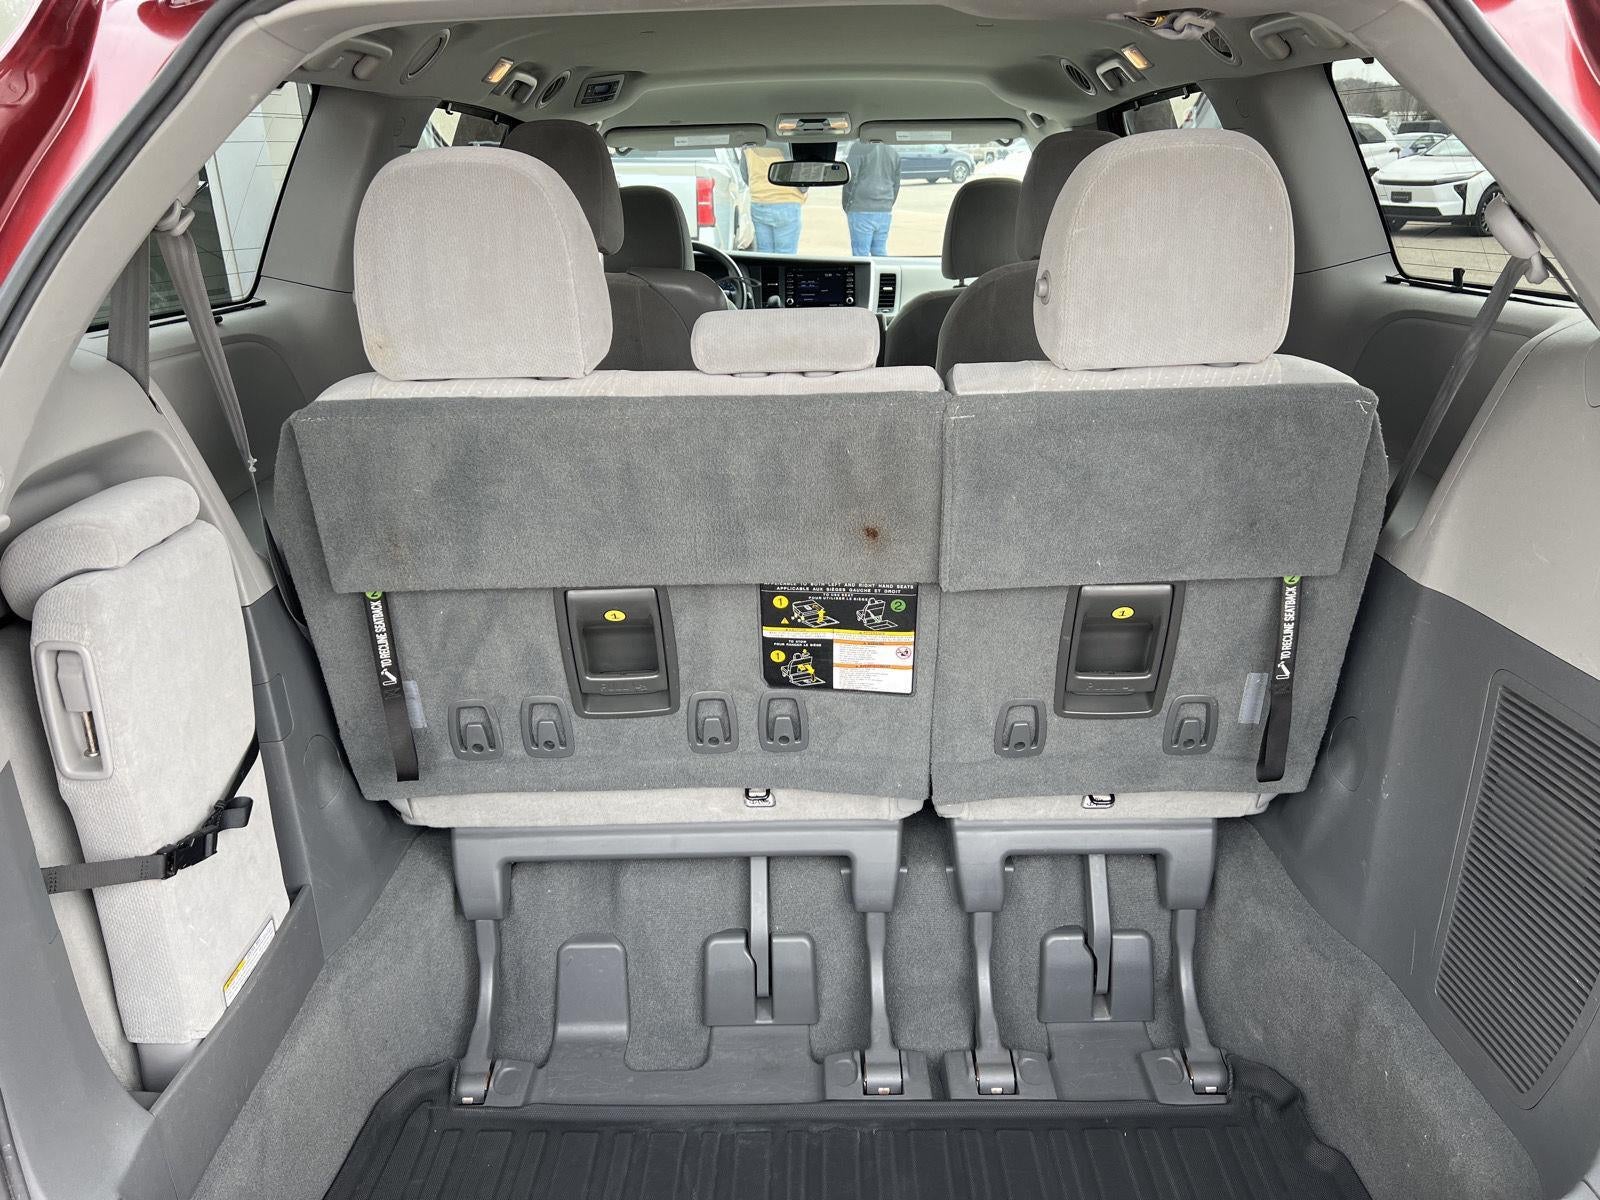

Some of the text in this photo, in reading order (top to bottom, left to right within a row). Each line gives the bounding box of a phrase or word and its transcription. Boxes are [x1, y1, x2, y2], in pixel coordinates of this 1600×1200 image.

[370, 601, 392, 668] TO RECLINE SEATBACK
[894, 601, 903, 610] 2
[1280, 586, 1296, 660] TO RECLINE SEATBACK
